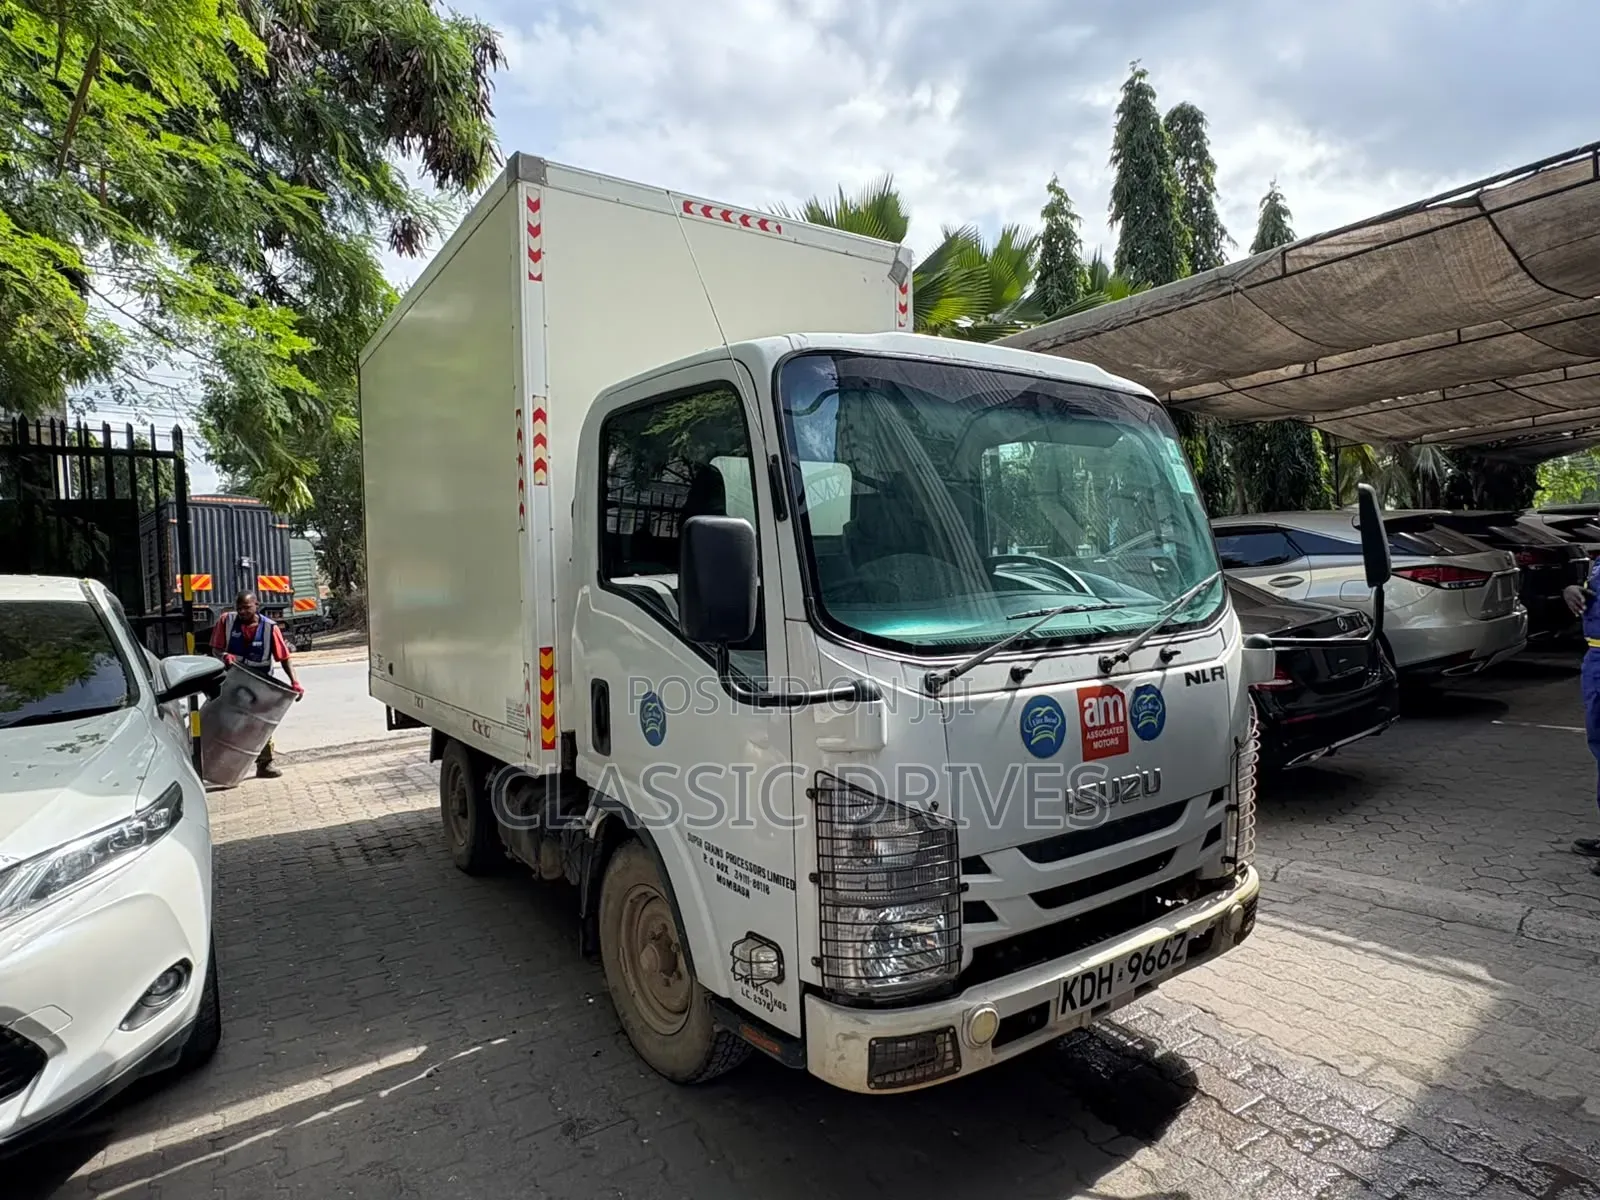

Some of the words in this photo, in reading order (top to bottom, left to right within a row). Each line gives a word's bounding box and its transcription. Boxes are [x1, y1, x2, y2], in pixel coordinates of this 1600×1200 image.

[1184, 665, 1225, 687] NLR
[1083, 694, 1125, 728] am
[1086, 725, 1125, 740] ASSOCIATED
[1092, 737, 1119, 749] MOTORS
[1065, 767, 1161, 816] ISUZU
[687, 832, 703, 848] SUPER
[704, 841, 724, 858] GRAINS
[726, 851, 766, 879] PROCESSORS
[767, 870, 796, 891] LIMITED
[716, 861, 729, 875] BOX
[716, 873, 750, 899] MOMBASA
[1061, 962, 1114, 1014] KDH
[1128, 931, 1187, 984] 966Z
